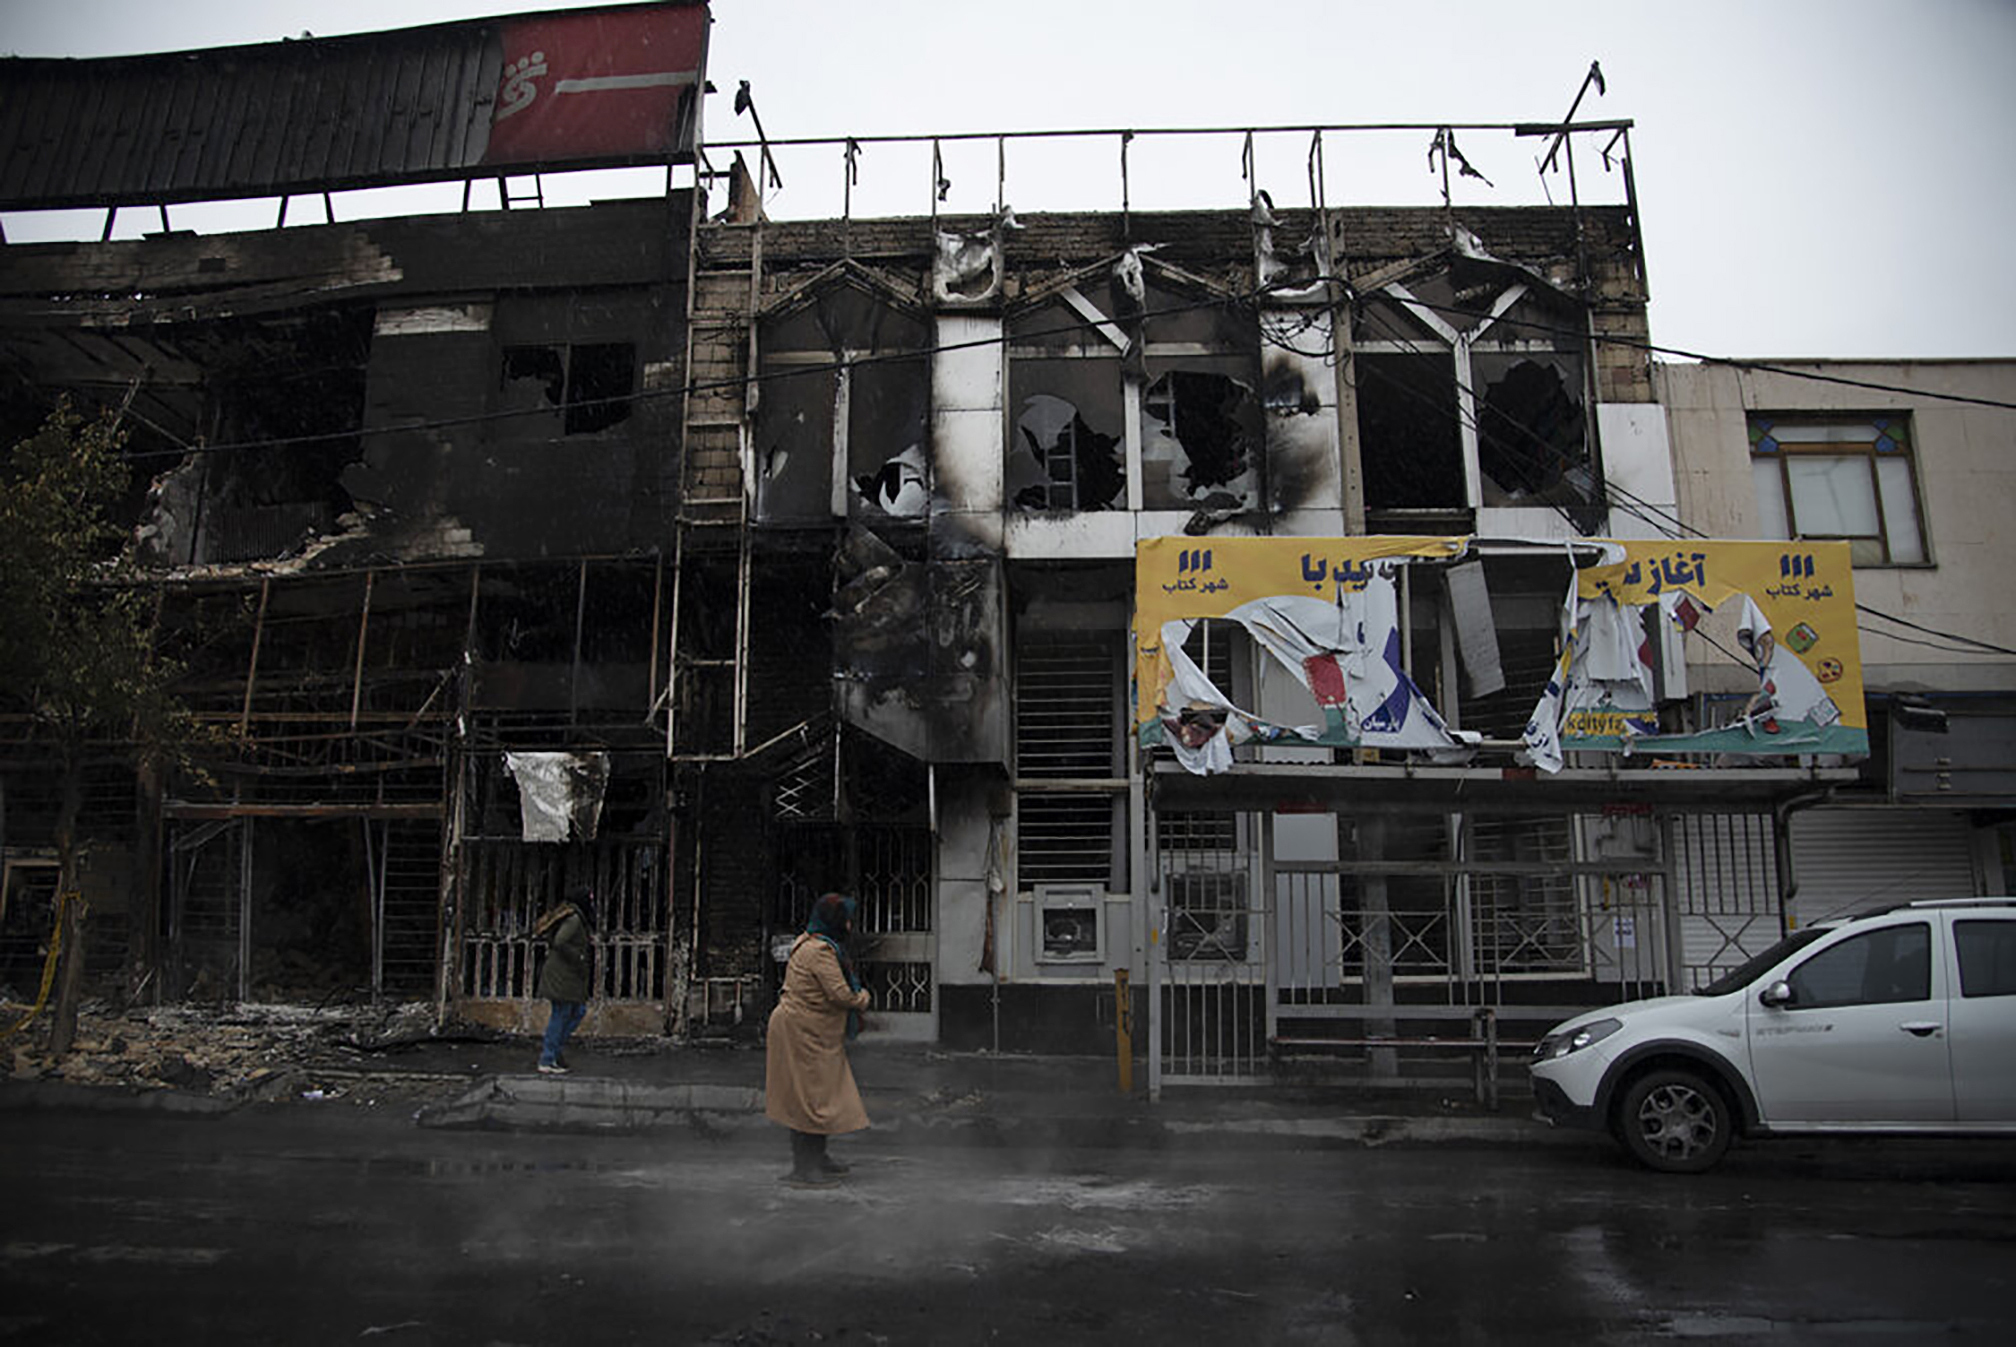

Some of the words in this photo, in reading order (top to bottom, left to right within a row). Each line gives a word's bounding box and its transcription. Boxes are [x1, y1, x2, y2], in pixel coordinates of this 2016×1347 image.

[1301, 553, 1327, 592] با
[1647, 552, 1706, 596] آغاز
[1161, 577, 1197, 595] کتاب
[1198, 576, 1229, 594] شهر
[1765, 582, 1802, 601] کتاب
[1803, 584, 1834, 602] شهر
